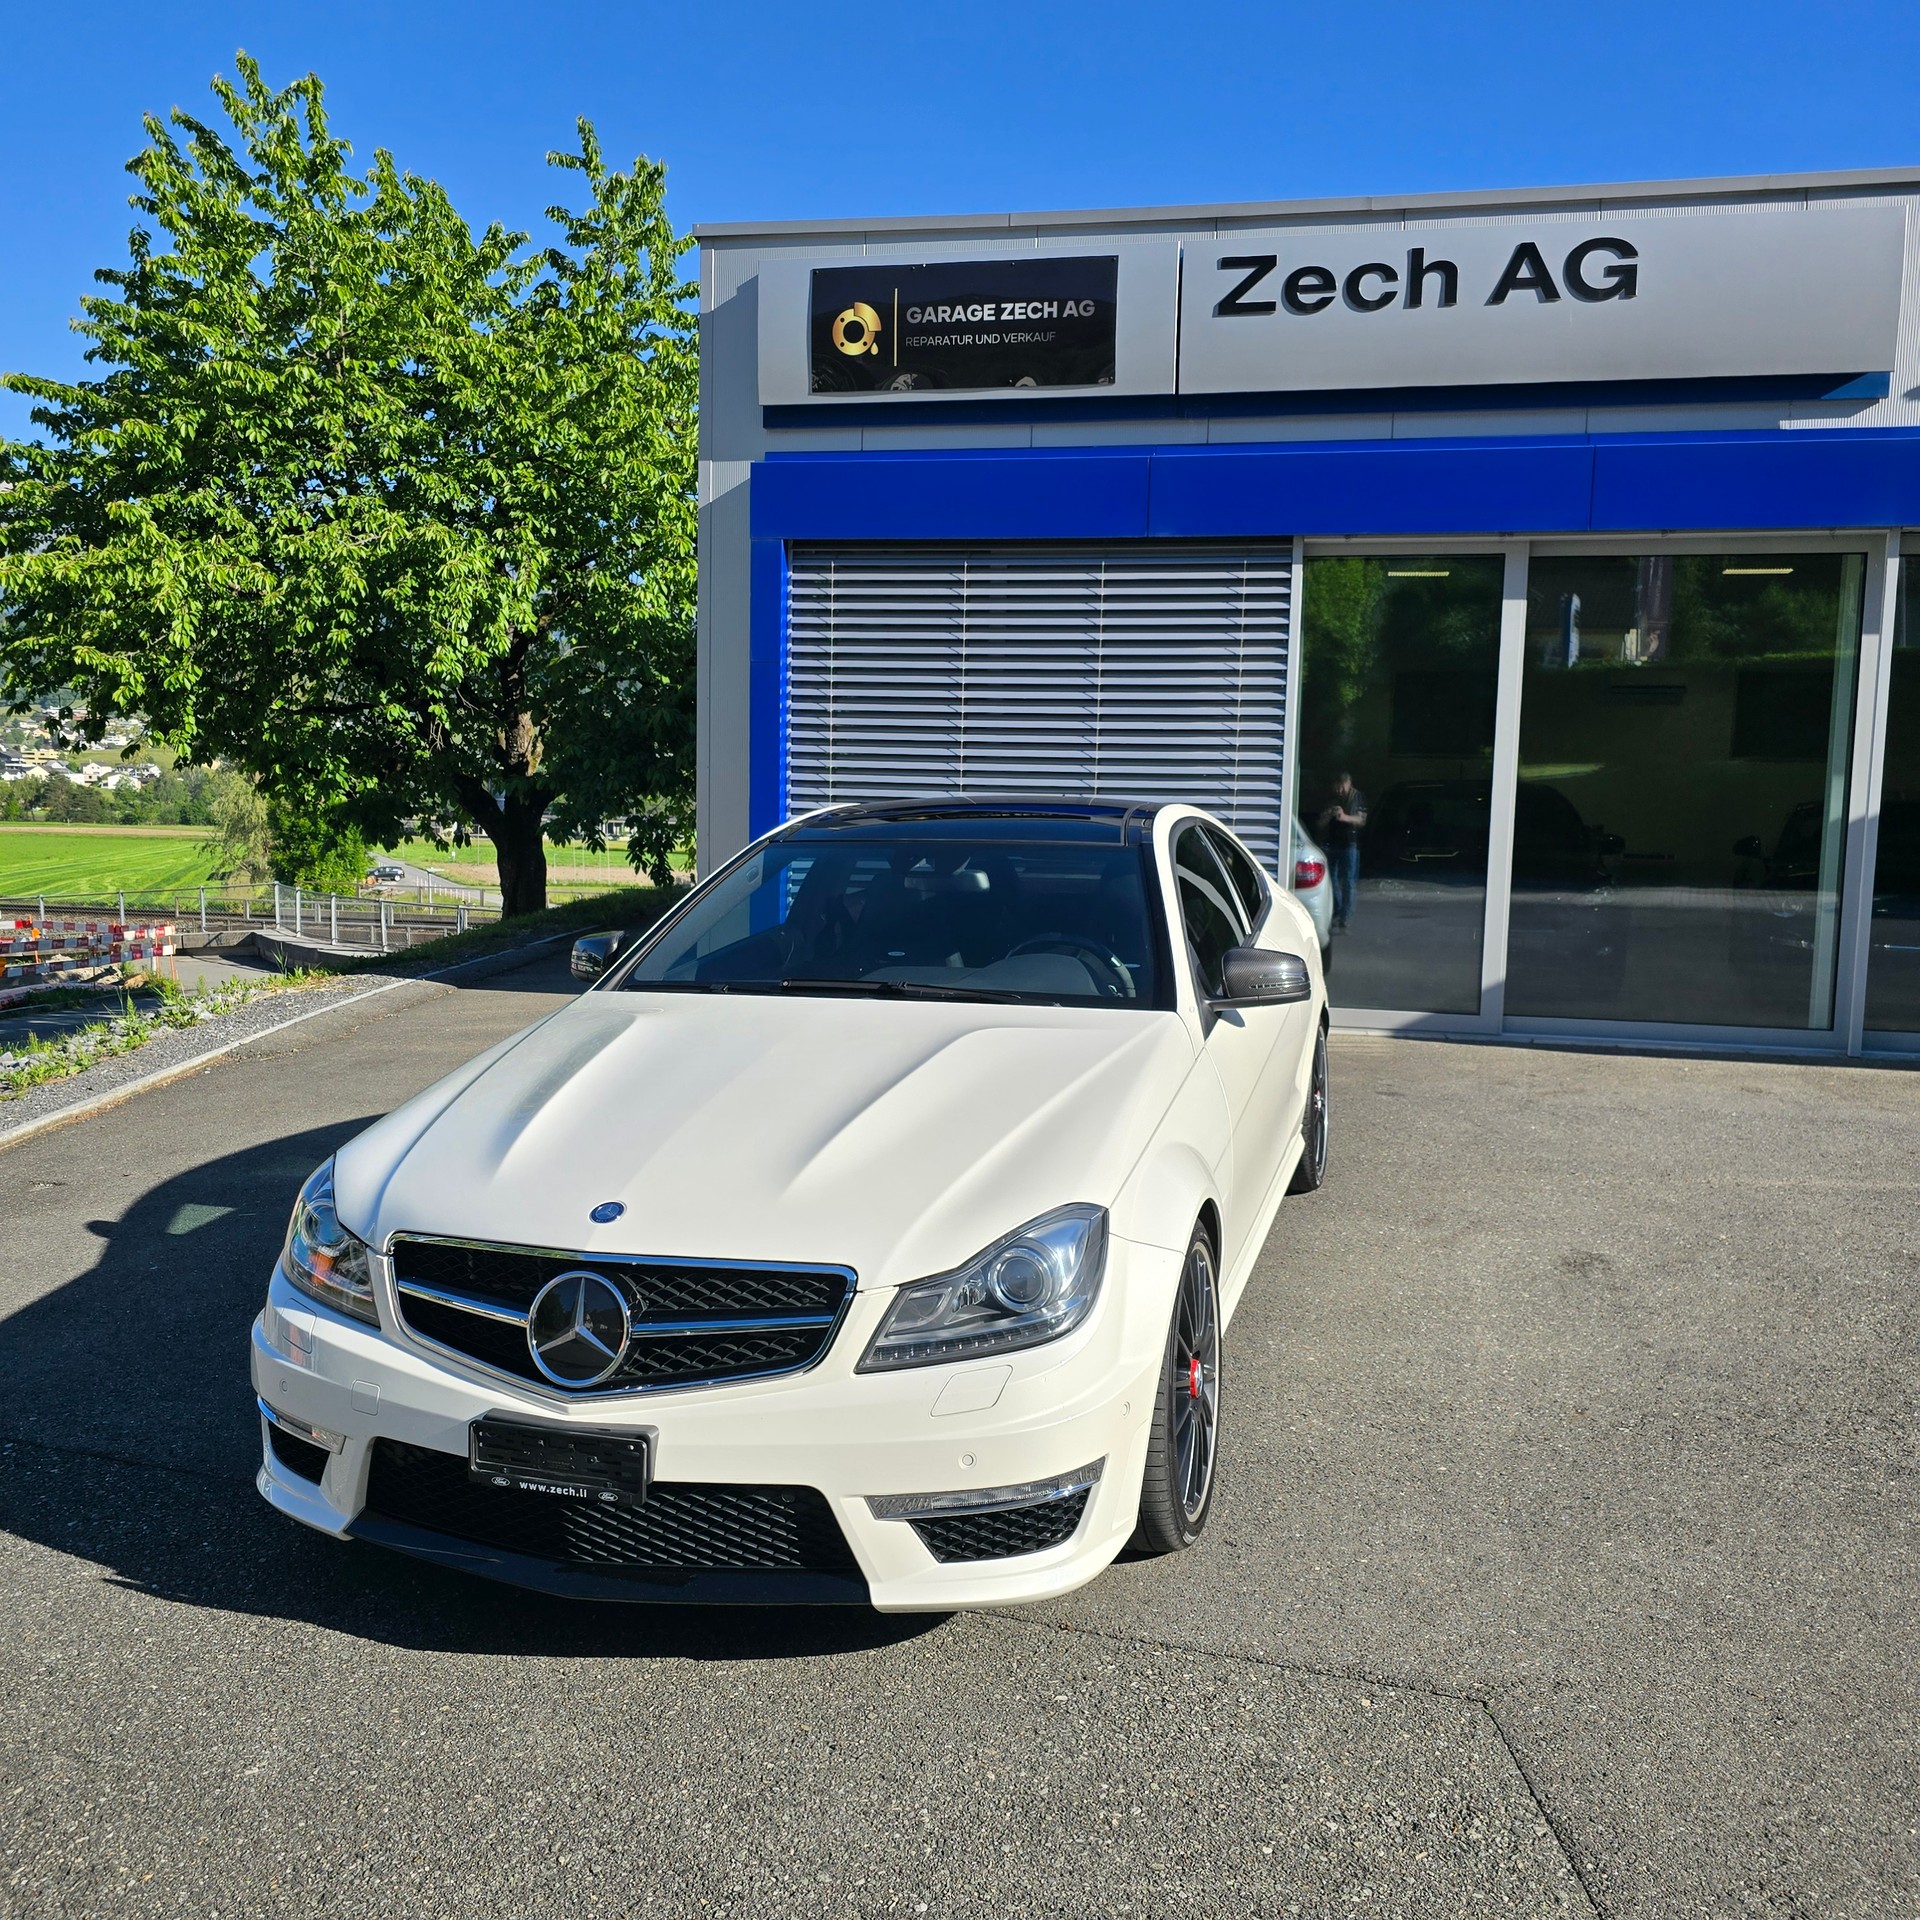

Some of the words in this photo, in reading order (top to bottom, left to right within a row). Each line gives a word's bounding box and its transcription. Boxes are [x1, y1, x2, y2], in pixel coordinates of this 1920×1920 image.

[1212, 247, 1459, 318] Zech
[1484, 237, 1639, 306] AG
[906, 304, 996, 324] GARAGE
[1000, 301, 1058, 321] ZECH
[1062, 299, 1095, 318] AG
[905, 335, 974, 348] REPARATUR
[975, 333, 1000, 345] UND
[1002, 331, 1056, 344] VERKAUF
[519, 1481, 587, 1498] www.zech.li
